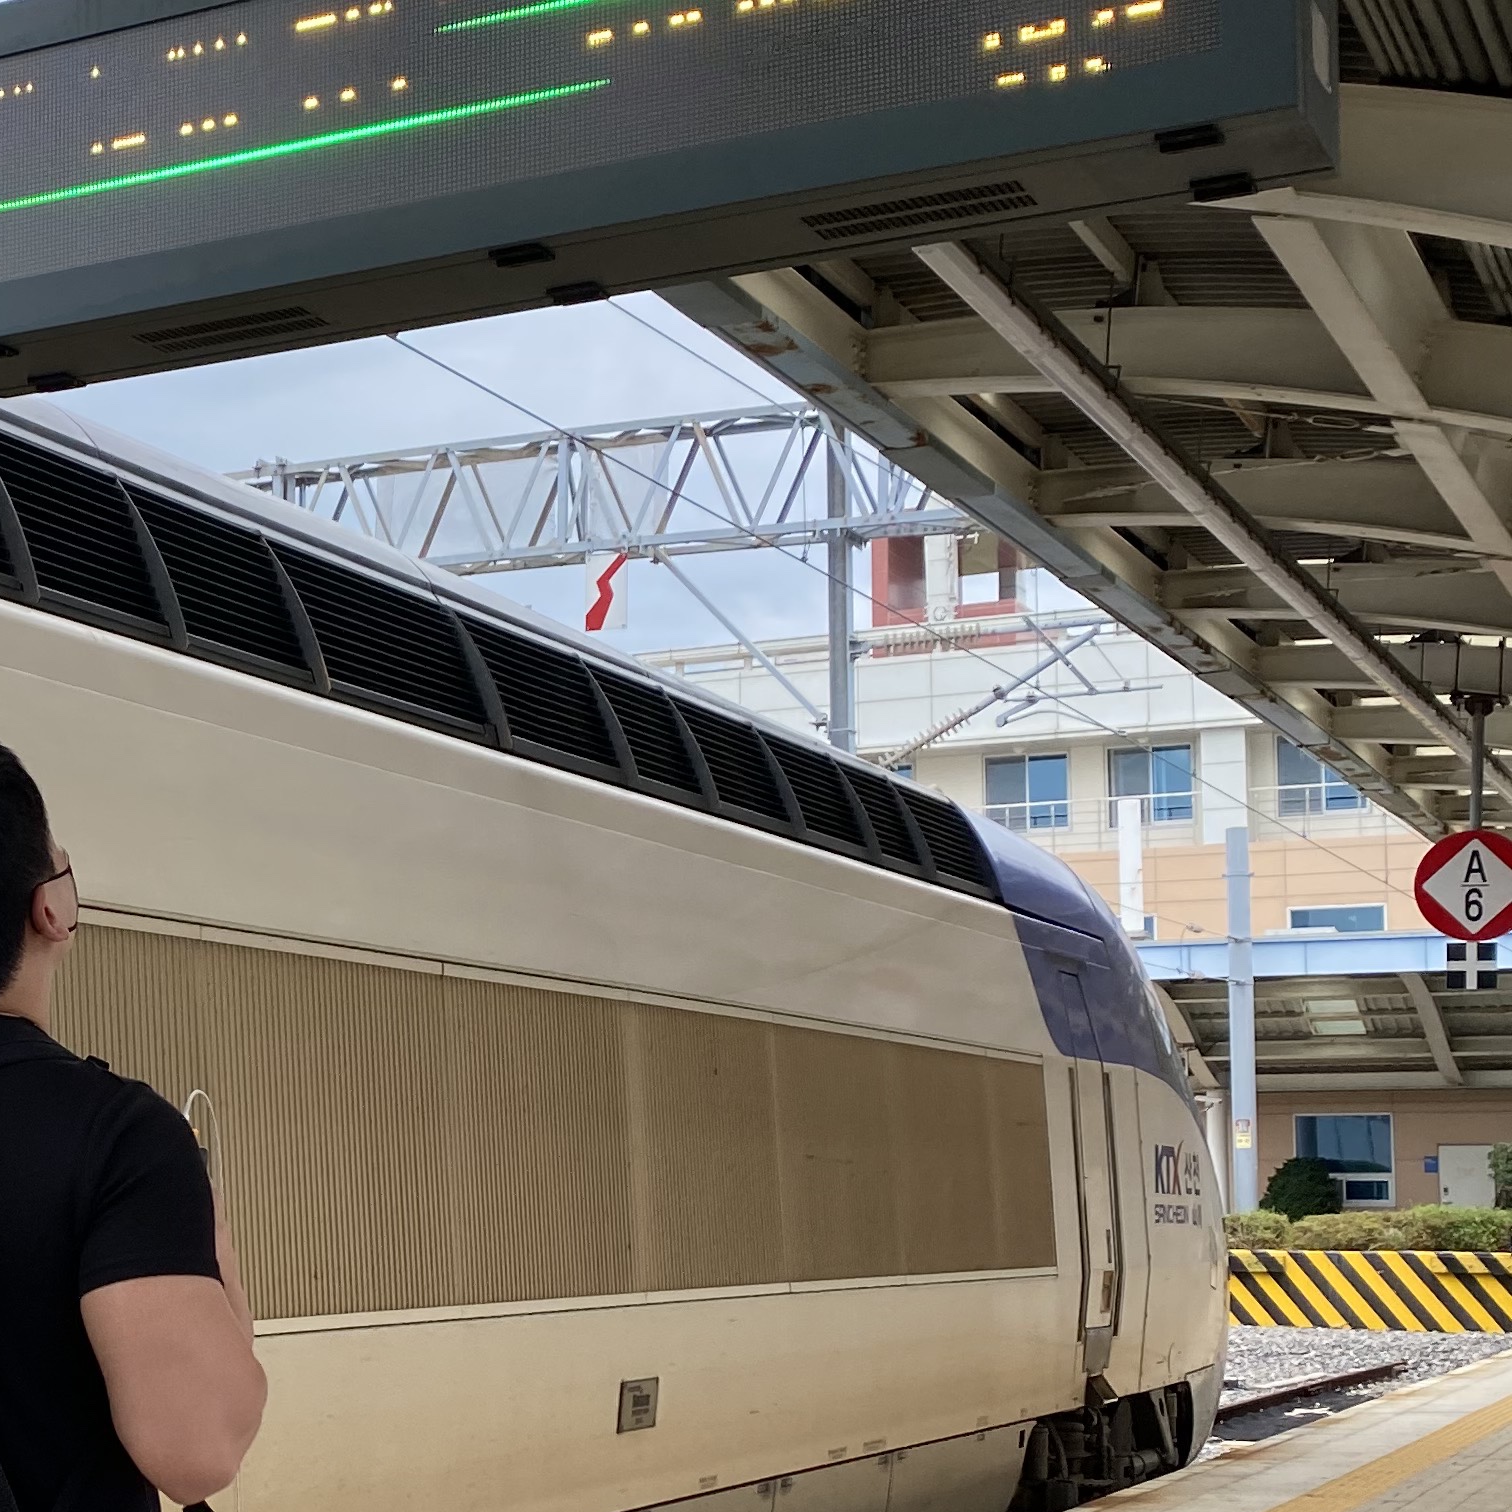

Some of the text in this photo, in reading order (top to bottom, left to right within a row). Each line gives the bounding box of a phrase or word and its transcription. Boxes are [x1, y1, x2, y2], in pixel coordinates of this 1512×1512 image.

[1463, 849, 1487, 883] A
[1464, 887, 1483, 922] 6
[1155, 1140, 1184, 1196] KTX
